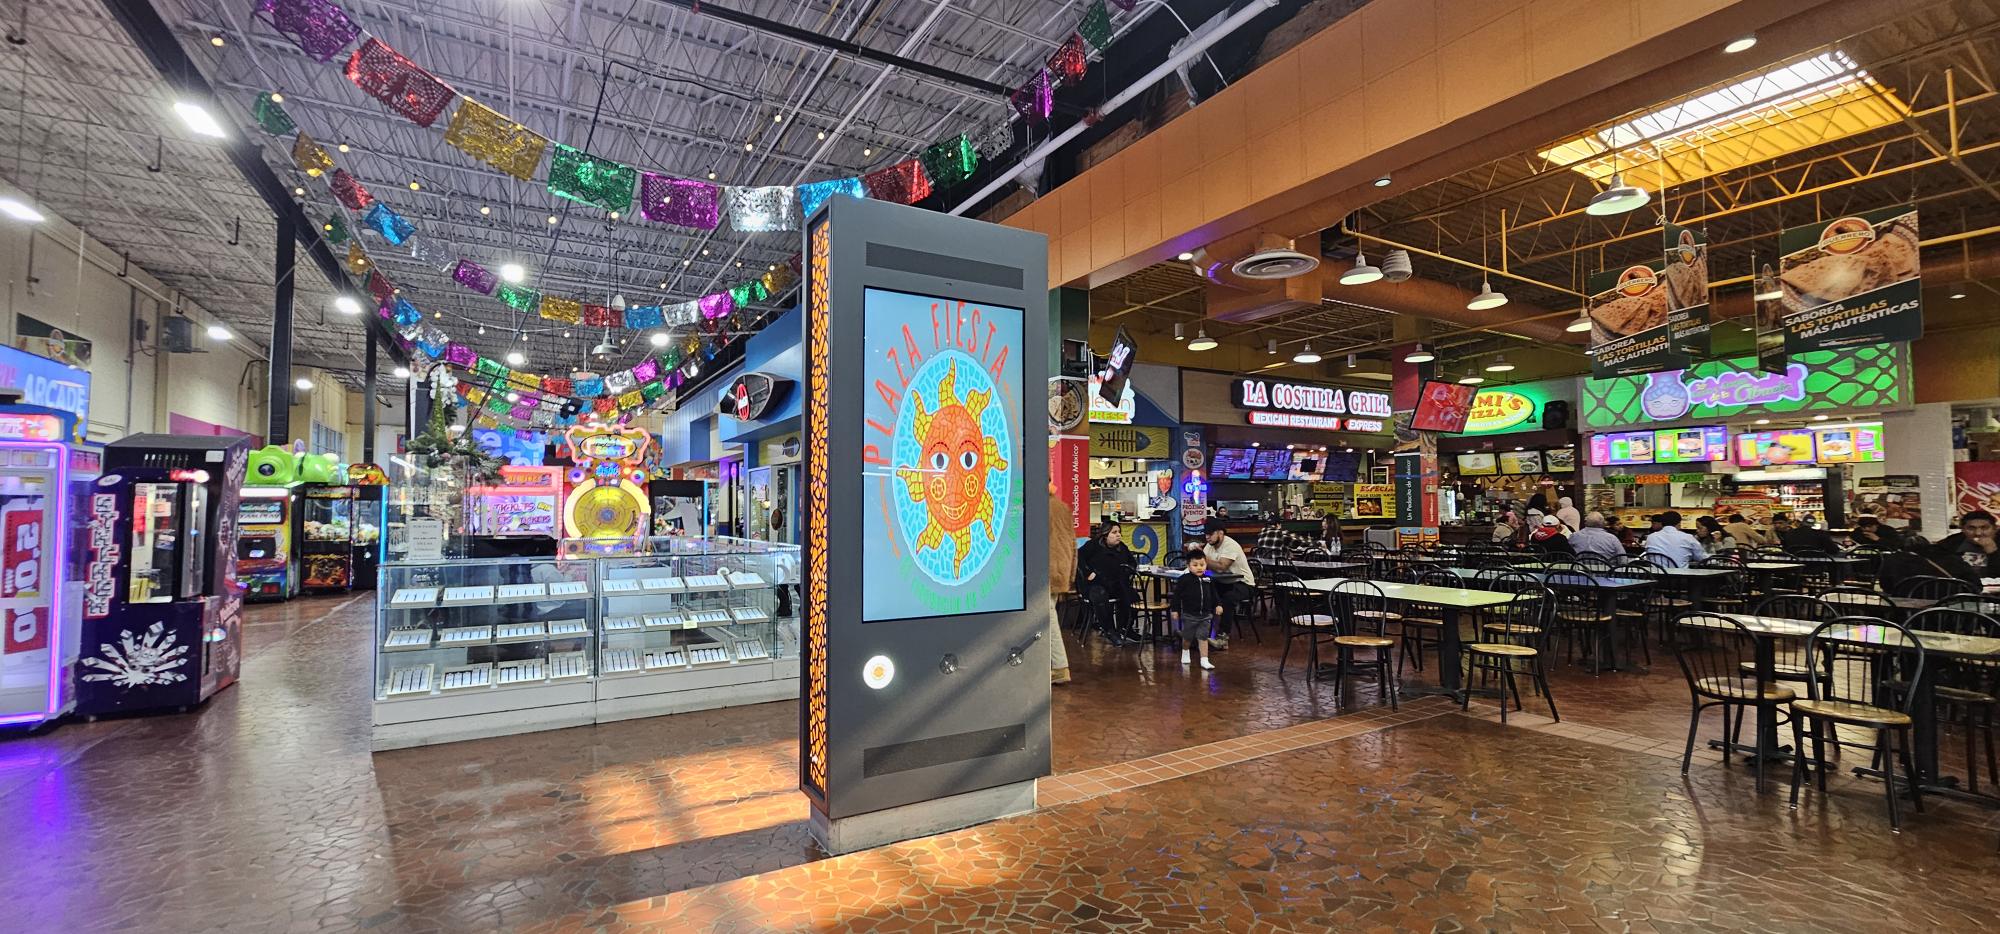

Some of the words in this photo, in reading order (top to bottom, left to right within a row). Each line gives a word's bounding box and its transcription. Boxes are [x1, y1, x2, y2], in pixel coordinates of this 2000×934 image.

[1785, 303, 1845, 327] SABOREA
[1791, 320, 1815, 334] LAS
[1818, 299, 1889, 326] TORTILLAS
[1800, 324, 1831, 340] MÁS
[1832, 299, 1920, 331] AUTÉNTICAS
[1592, 337, 1636, 357] SABOREA
[1597, 350, 1615, 362] LAS
[1614, 335, 1667, 355] TORTILLAS
[1603, 353, 1626, 368] MÁS
[24, 373, 87, 415] ARCADE
[863, 324, 923, 466] PLAZA
[931, 300, 1009, 385] FIESTA
[1244, 381, 1267, 405] LA
[1273, 385, 1345, 413] COSTILLA
[1349, 391, 1391, 416] GRILL
[1254, 411, 1289, 427] MEXICAN
[1290, 414, 1336, 429] RESTAURANT
[1348, 420, 1382, 432] EXPRESS
[1072, 474, 1079, 483] de
[1073, 518, 1079, 529] Un
[1406, 512, 1413, 521] Un
